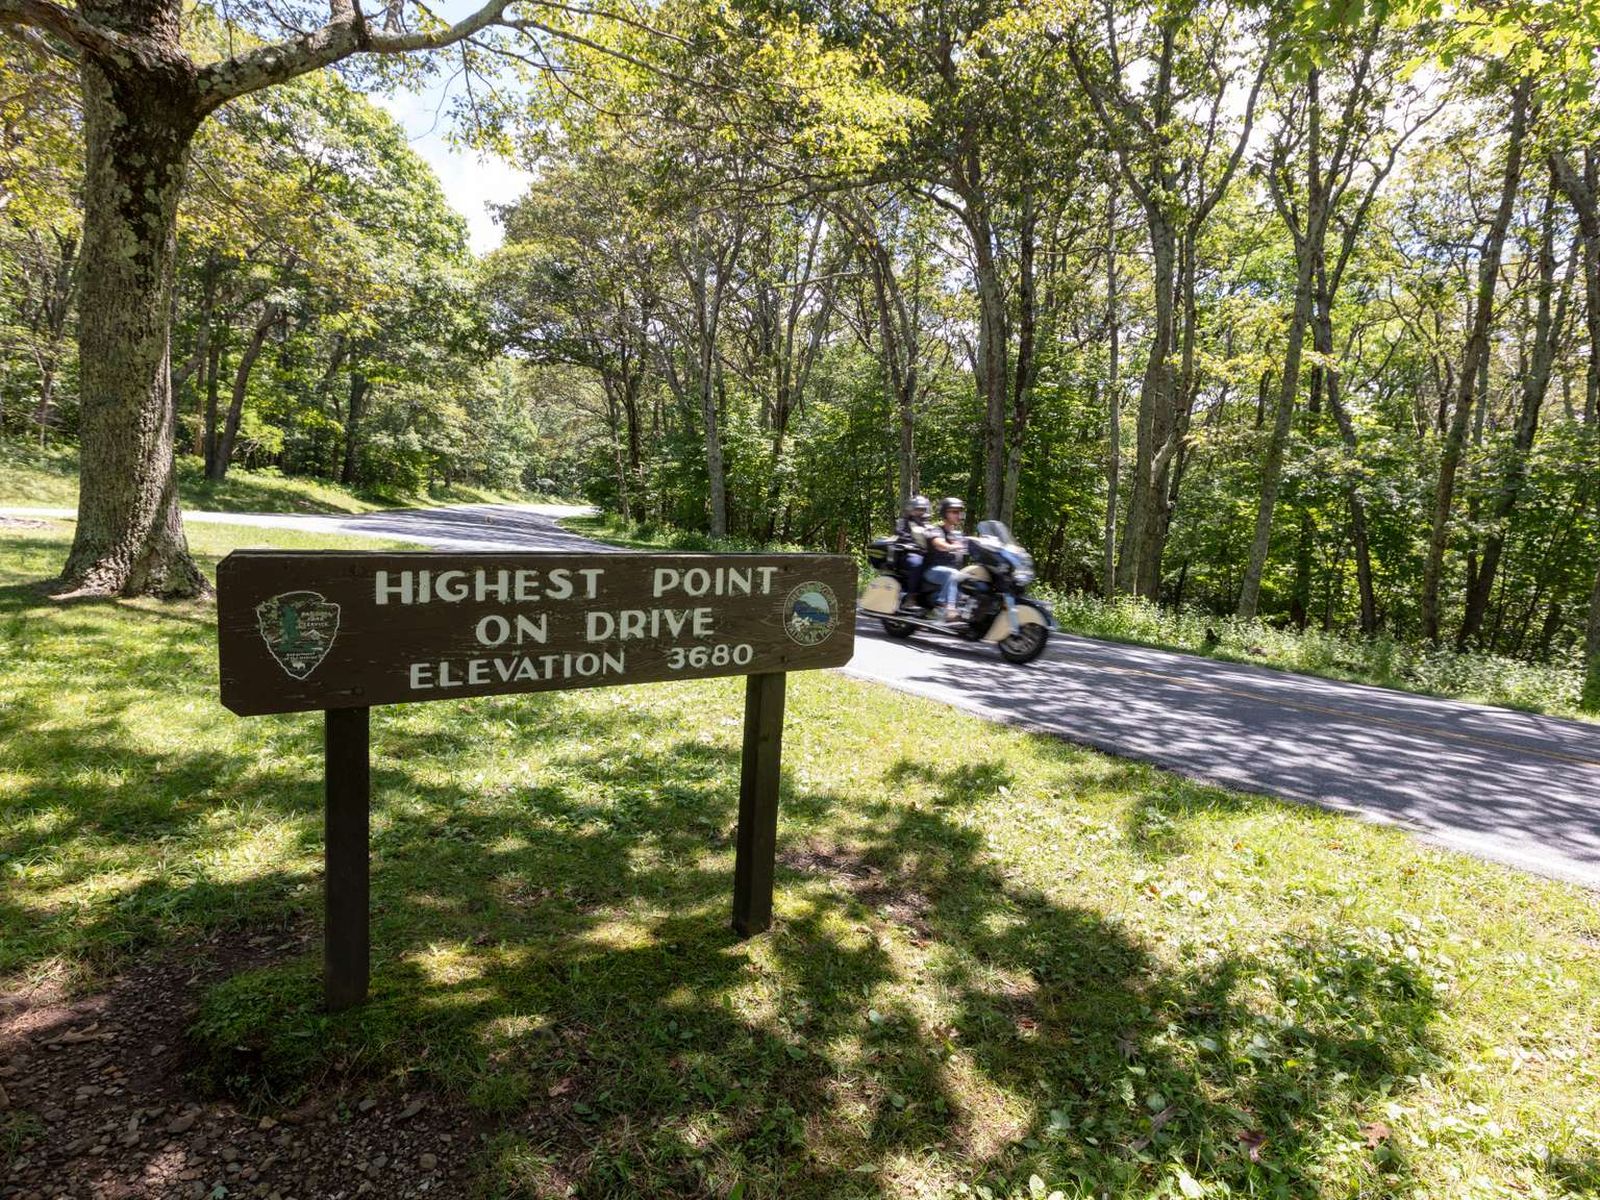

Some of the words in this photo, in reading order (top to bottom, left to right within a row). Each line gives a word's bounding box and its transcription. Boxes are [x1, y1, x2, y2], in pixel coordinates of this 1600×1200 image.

[375, 568, 605, 606] HIGHEST
[652, 567, 779, 599] POINT
[475, 614, 549, 648] ON
[586, 608, 714, 643] DRIVE
[409, 652, 625, 690] ELEVATION
[667, 643, 755, 671] 3680
